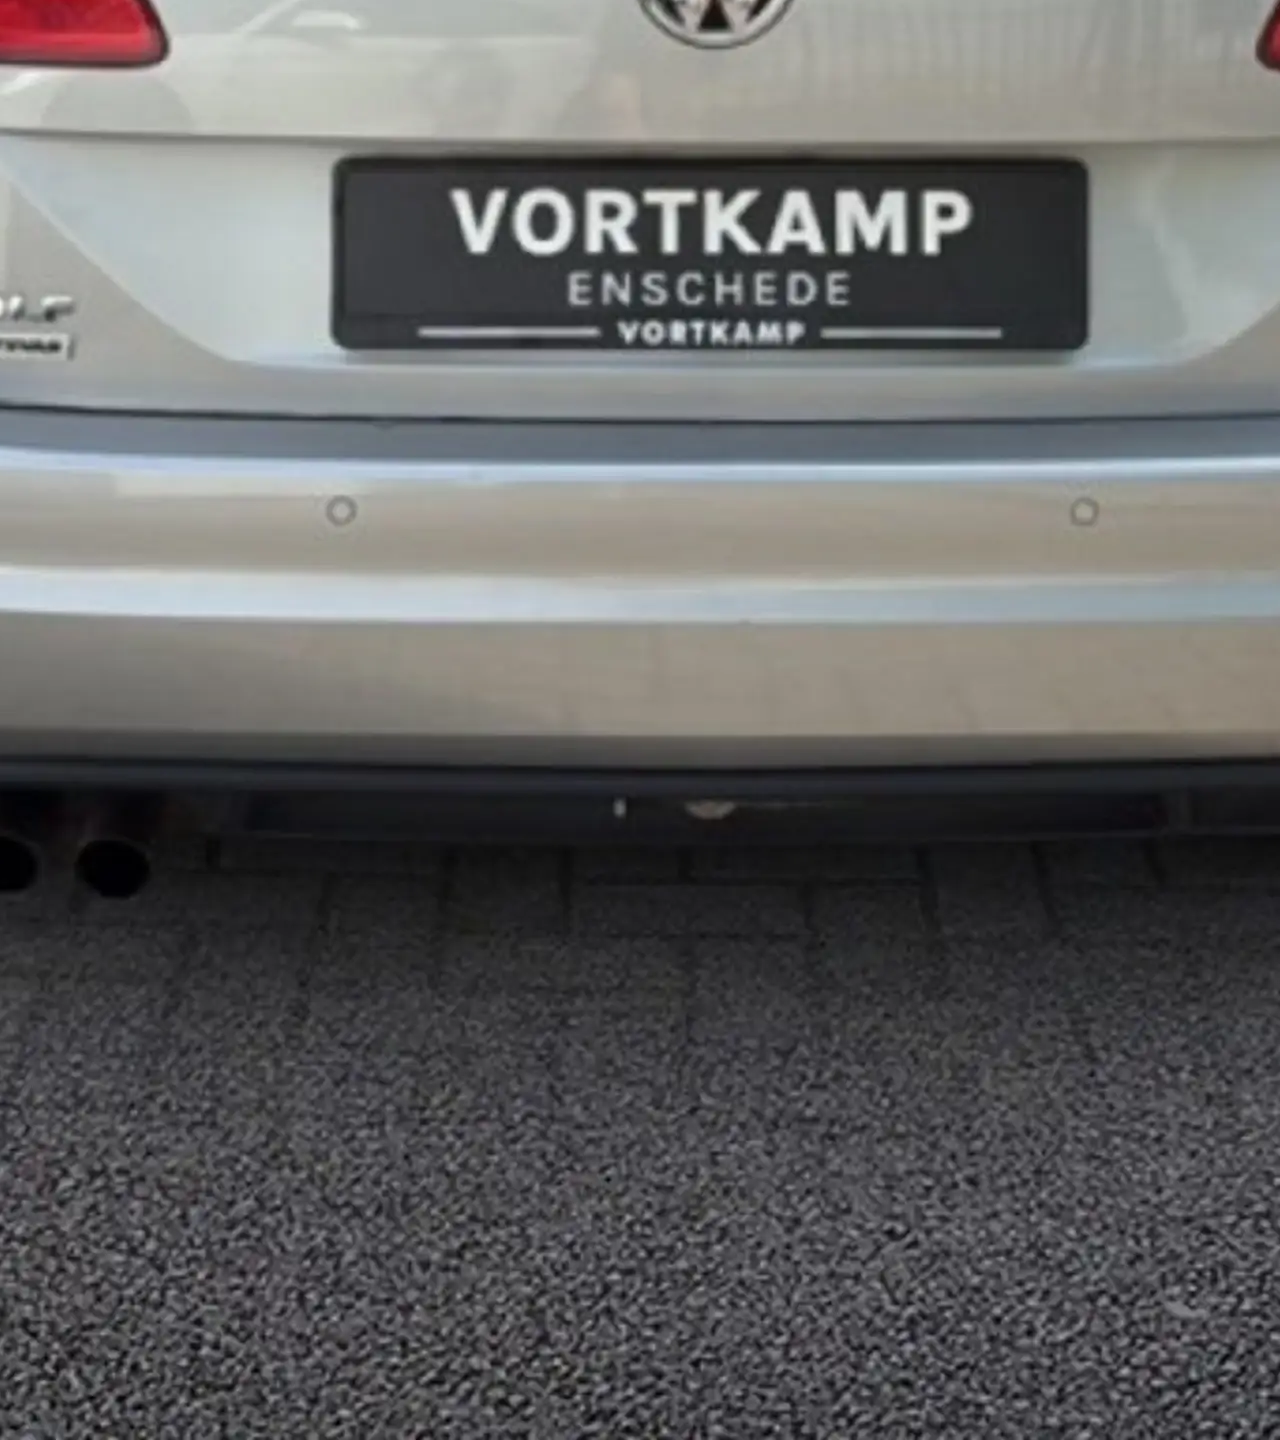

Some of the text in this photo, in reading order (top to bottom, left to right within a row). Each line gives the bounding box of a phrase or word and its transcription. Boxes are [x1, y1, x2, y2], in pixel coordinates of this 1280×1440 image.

[449, 187, 972, 256] VORTKAMP
[567, 271, 851, 306] ENSCHEDE
[617, 320, 806, 346] VORTKAMP
